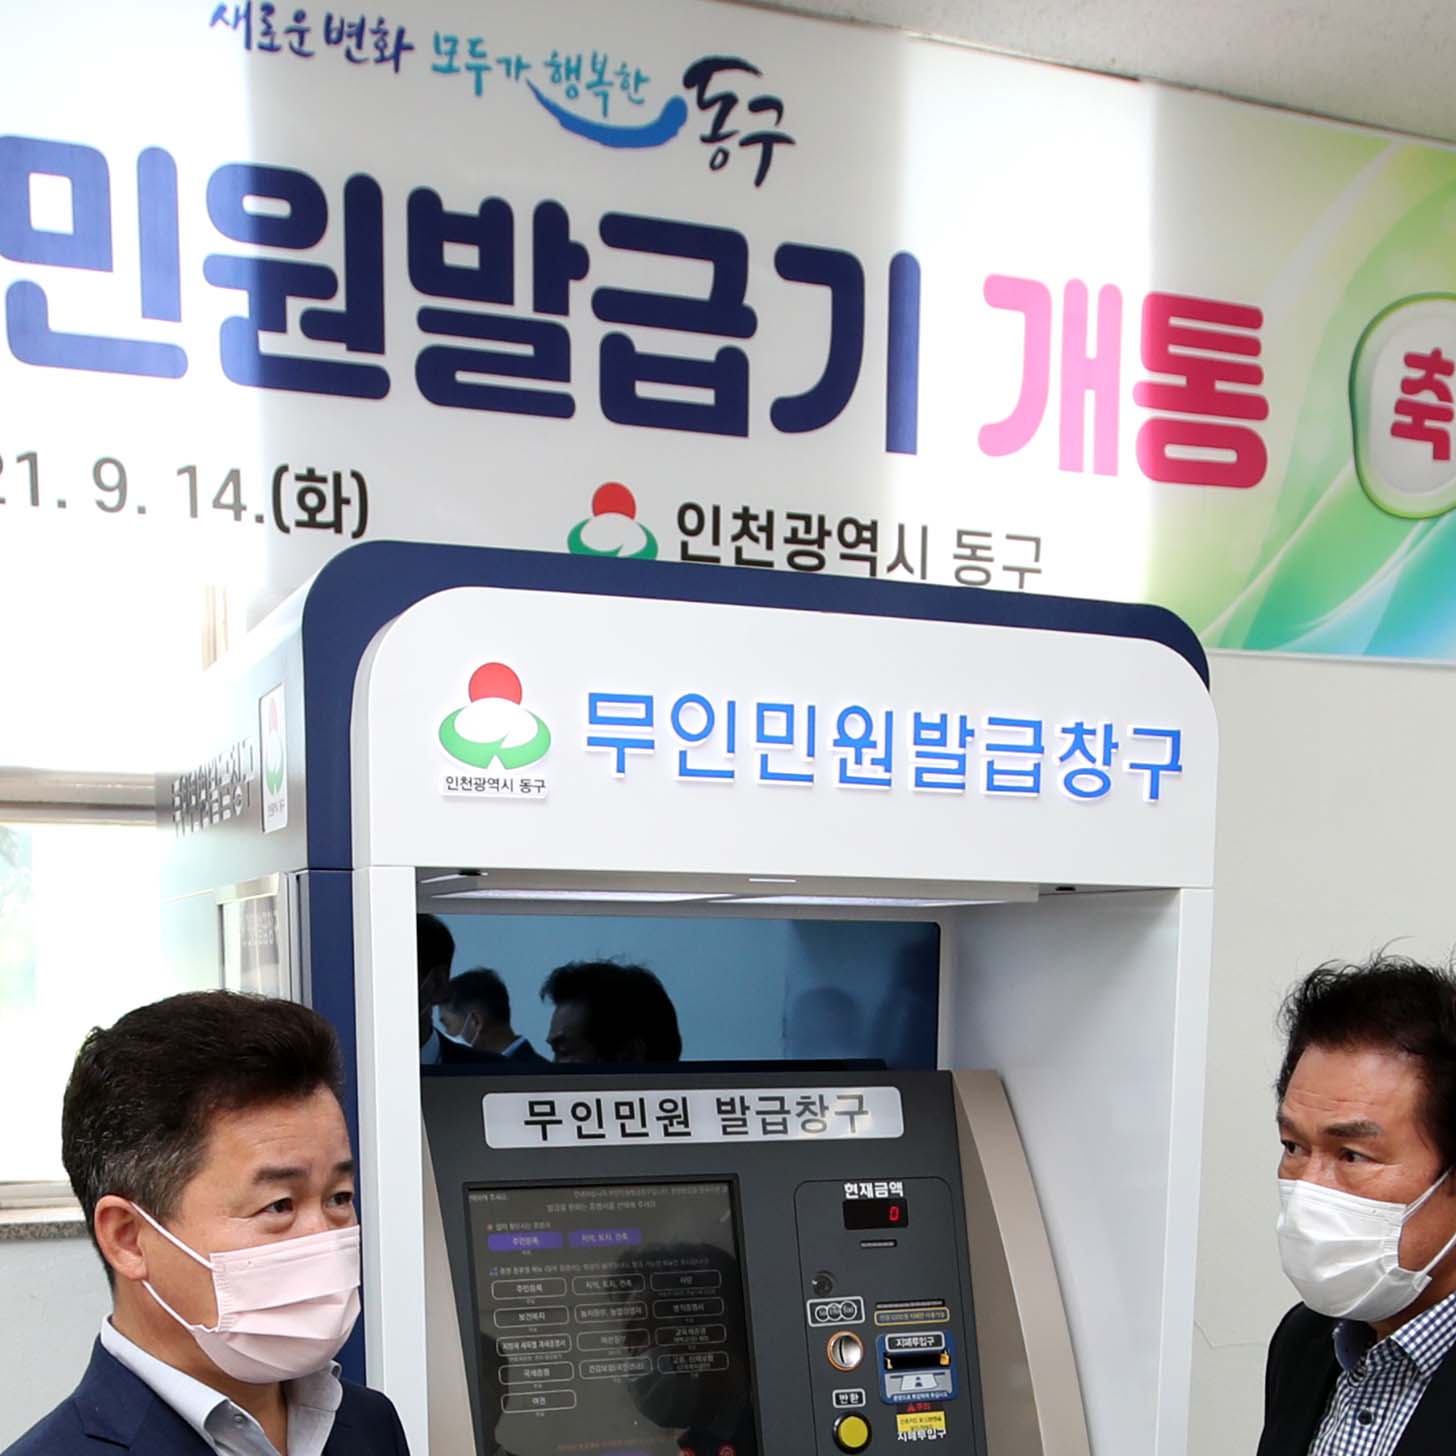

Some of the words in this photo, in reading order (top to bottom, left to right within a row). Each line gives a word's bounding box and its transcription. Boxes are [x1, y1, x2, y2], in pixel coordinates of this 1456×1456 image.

[431, 32, 531, 94] 모두가
[544, 50, 650, 118] 행복한
[683, 56, 796, 187] 동구
[977, 273, 1269, 489] 개통
[1391, 347, 1455, 462] 축
[92, 457, 146, 514] 9.
[676, 501, 928, 580] 인천광역시
[953, 528, 1043, 589] 동구
[585, 692, 1184, 801] 무인민원발급창구
[446, 776, 514, 792] 인천광역시
[519, 778, 546, 793] 동구
[524, 1096, 692, 1141] 무인민원
[716, 1093, 870, 1136] 발급창구
[844, 1181, 904, 1199] 현재금액
[889, 1206, 900, 1221] 0
[896, 1336, 935, 1348] 지폐투입구
